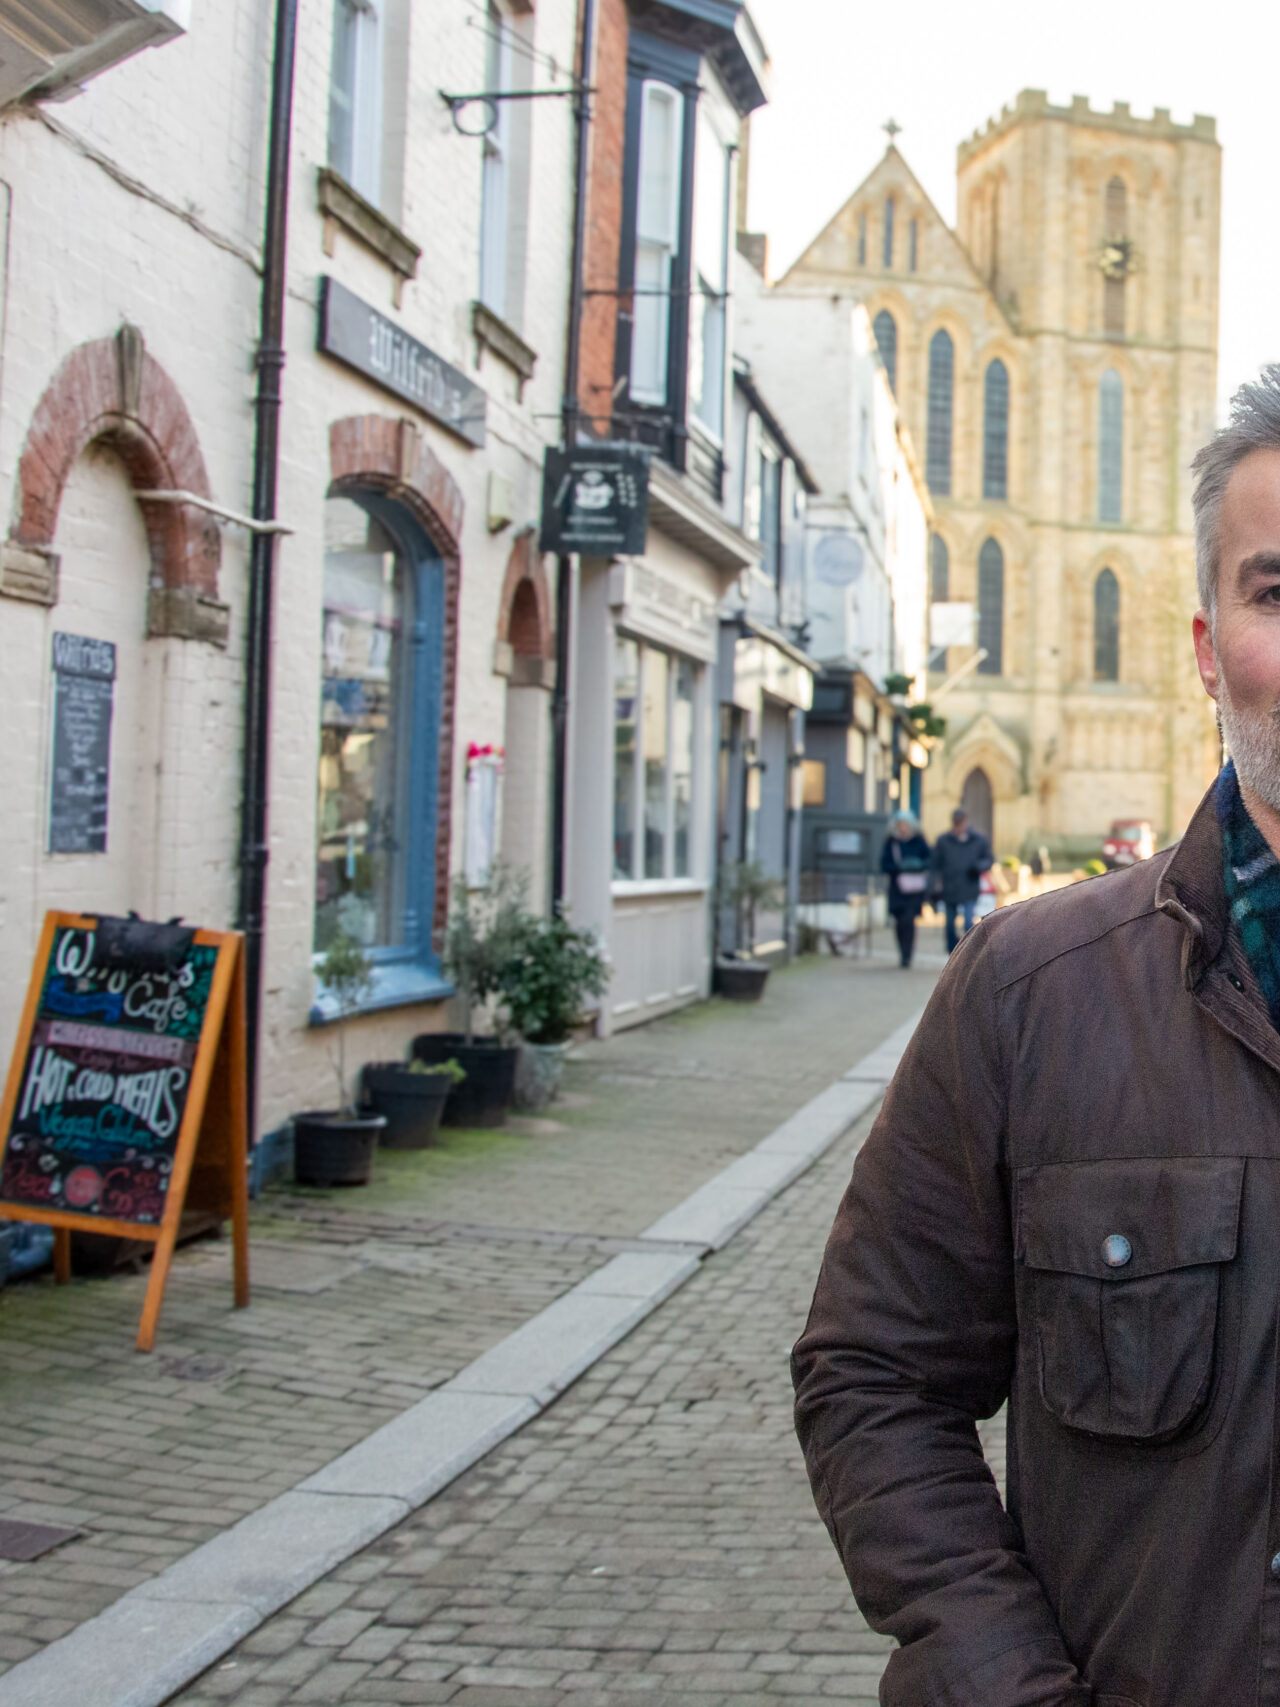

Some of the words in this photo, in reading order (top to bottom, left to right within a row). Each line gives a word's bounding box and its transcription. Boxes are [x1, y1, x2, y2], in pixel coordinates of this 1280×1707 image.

[19, 1045, 77, 1120] HOT
[75, 1069, 115, 1101] COLD
[113, 1066, 188, 1138] MEALS
